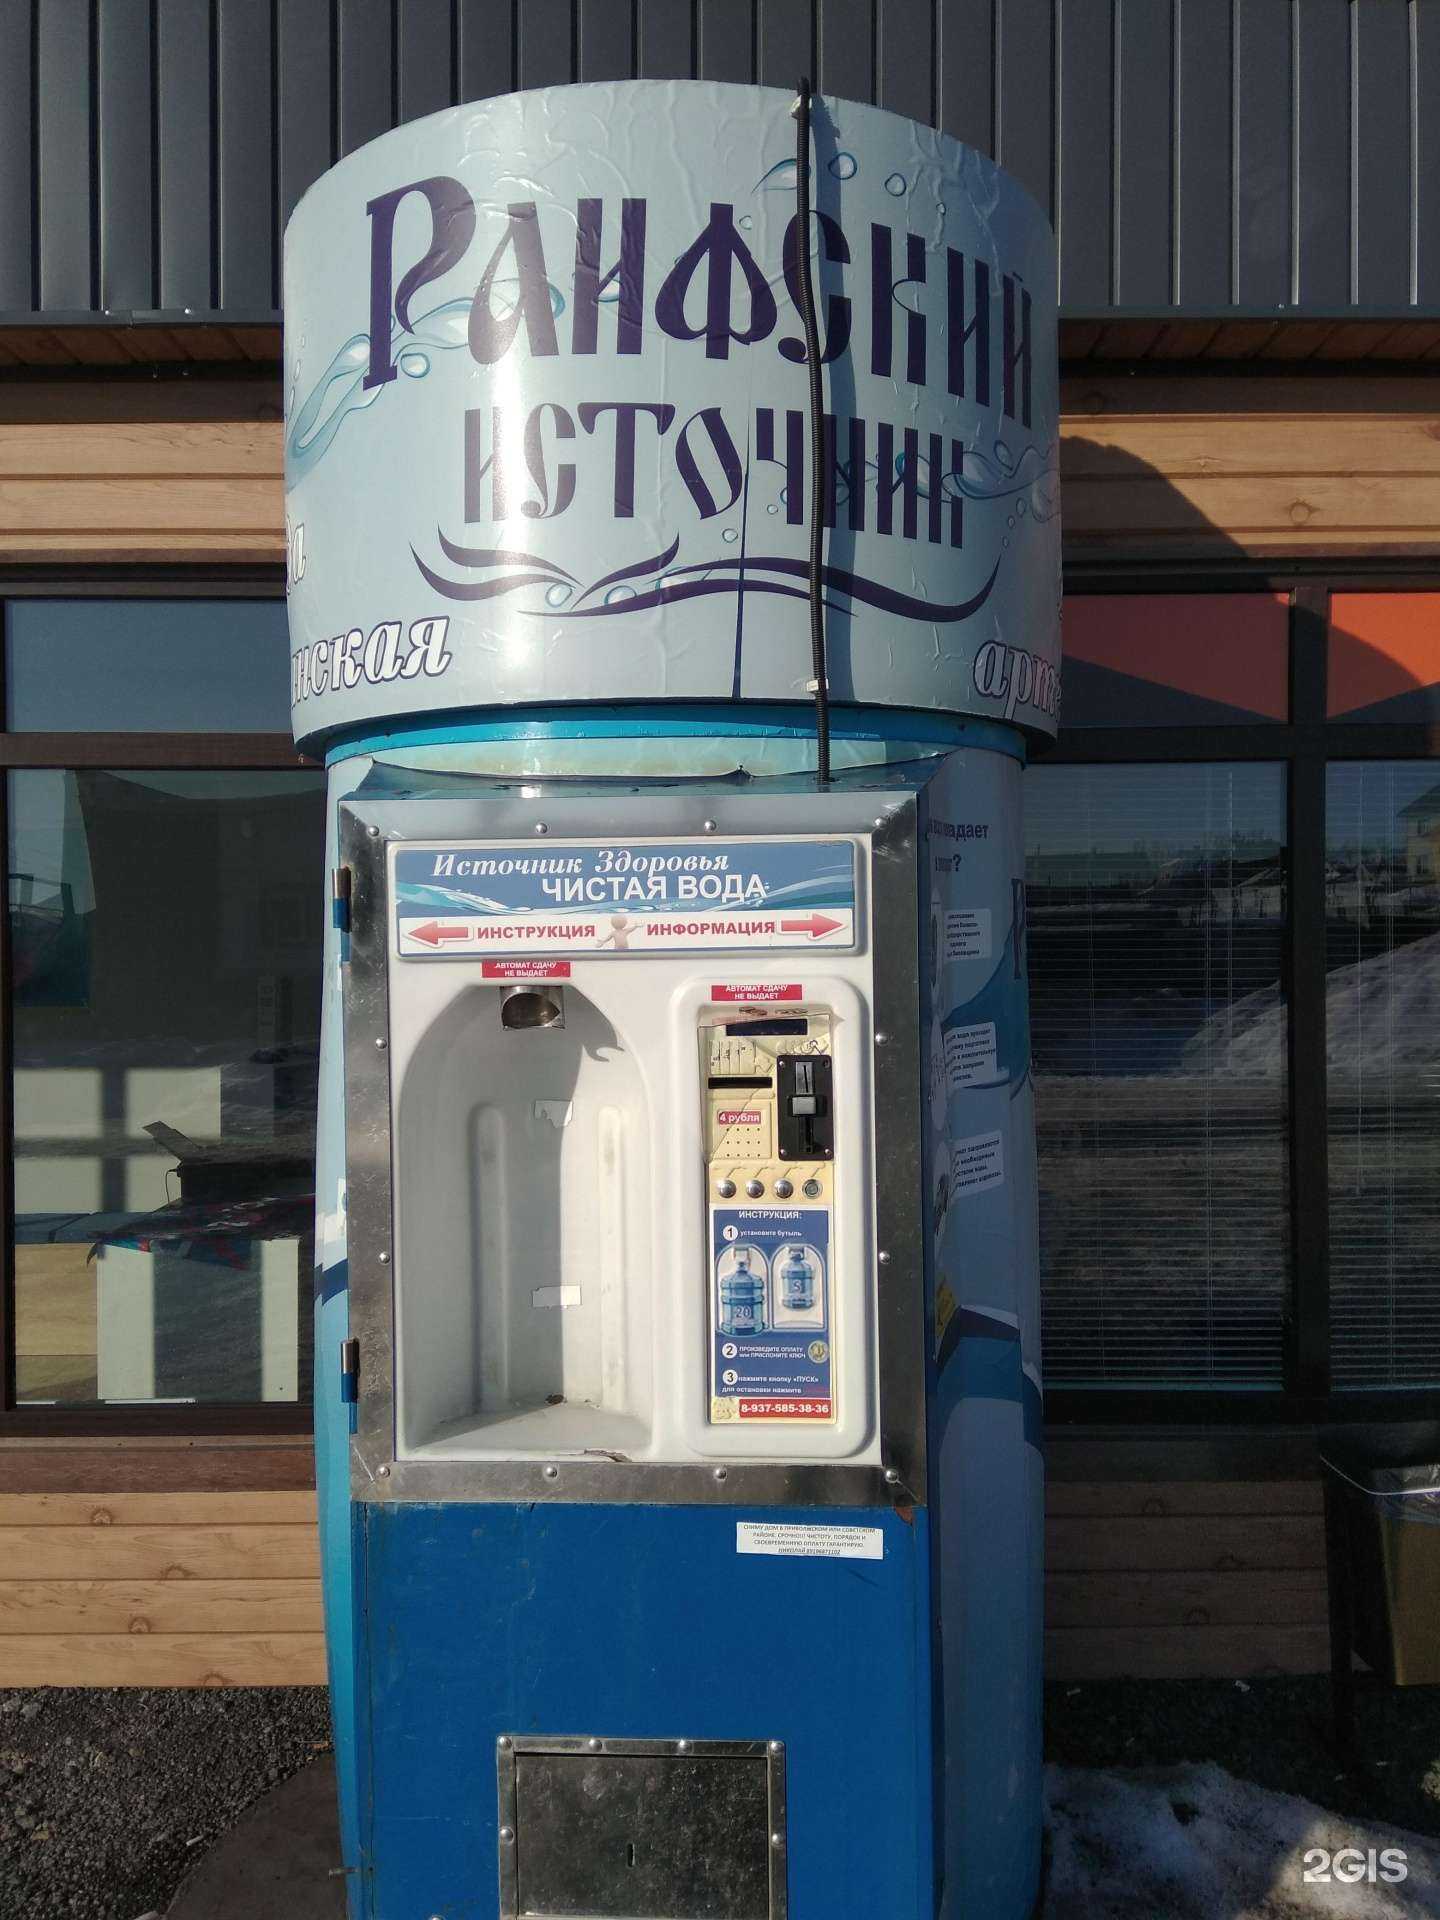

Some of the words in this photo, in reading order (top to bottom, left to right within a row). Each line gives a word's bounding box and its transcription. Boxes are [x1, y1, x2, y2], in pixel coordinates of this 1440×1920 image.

[433, 854, 584, 877] Источник
[595, 850, 729, 877] Здоровья
[543, 875, 667, 902] ЧИСТАЯ
[678, 874, 767, 903] ВОДА
[477, 924, 596, 940] ИНСТРУКЦИЯ
[647, 920, 776, 936] ИНФОРМАЦИЯ
[495, 962, 531, 970] АВТОМАТ
[532, 962, 557, 970] СДАЧУ
[517, 969, 547, 977] ВЫДАЕТ
[726, 984, 762, 992] АВТОМАТ
[763, 984, 788, 992] СДАЧУ
[747, 992, 779, 1000] ВЫДАЕТ
[720, 1113, 726, 1121] 4
[729, 1113, 760, 1124] рубля
[738, 1210, 803, 1220] ИНСТРУКЦИЯ:
[728, 1227, 733, 1237] 1
[740, 1230, 776, 1238] установите
[777, 1229, 802, 1238] бутыль
[726, 1345, 733, 1355] 2
[727, 1371, 734, 1382] 3
[741, 1403, 830, 1414] 8-937-585-38-36
